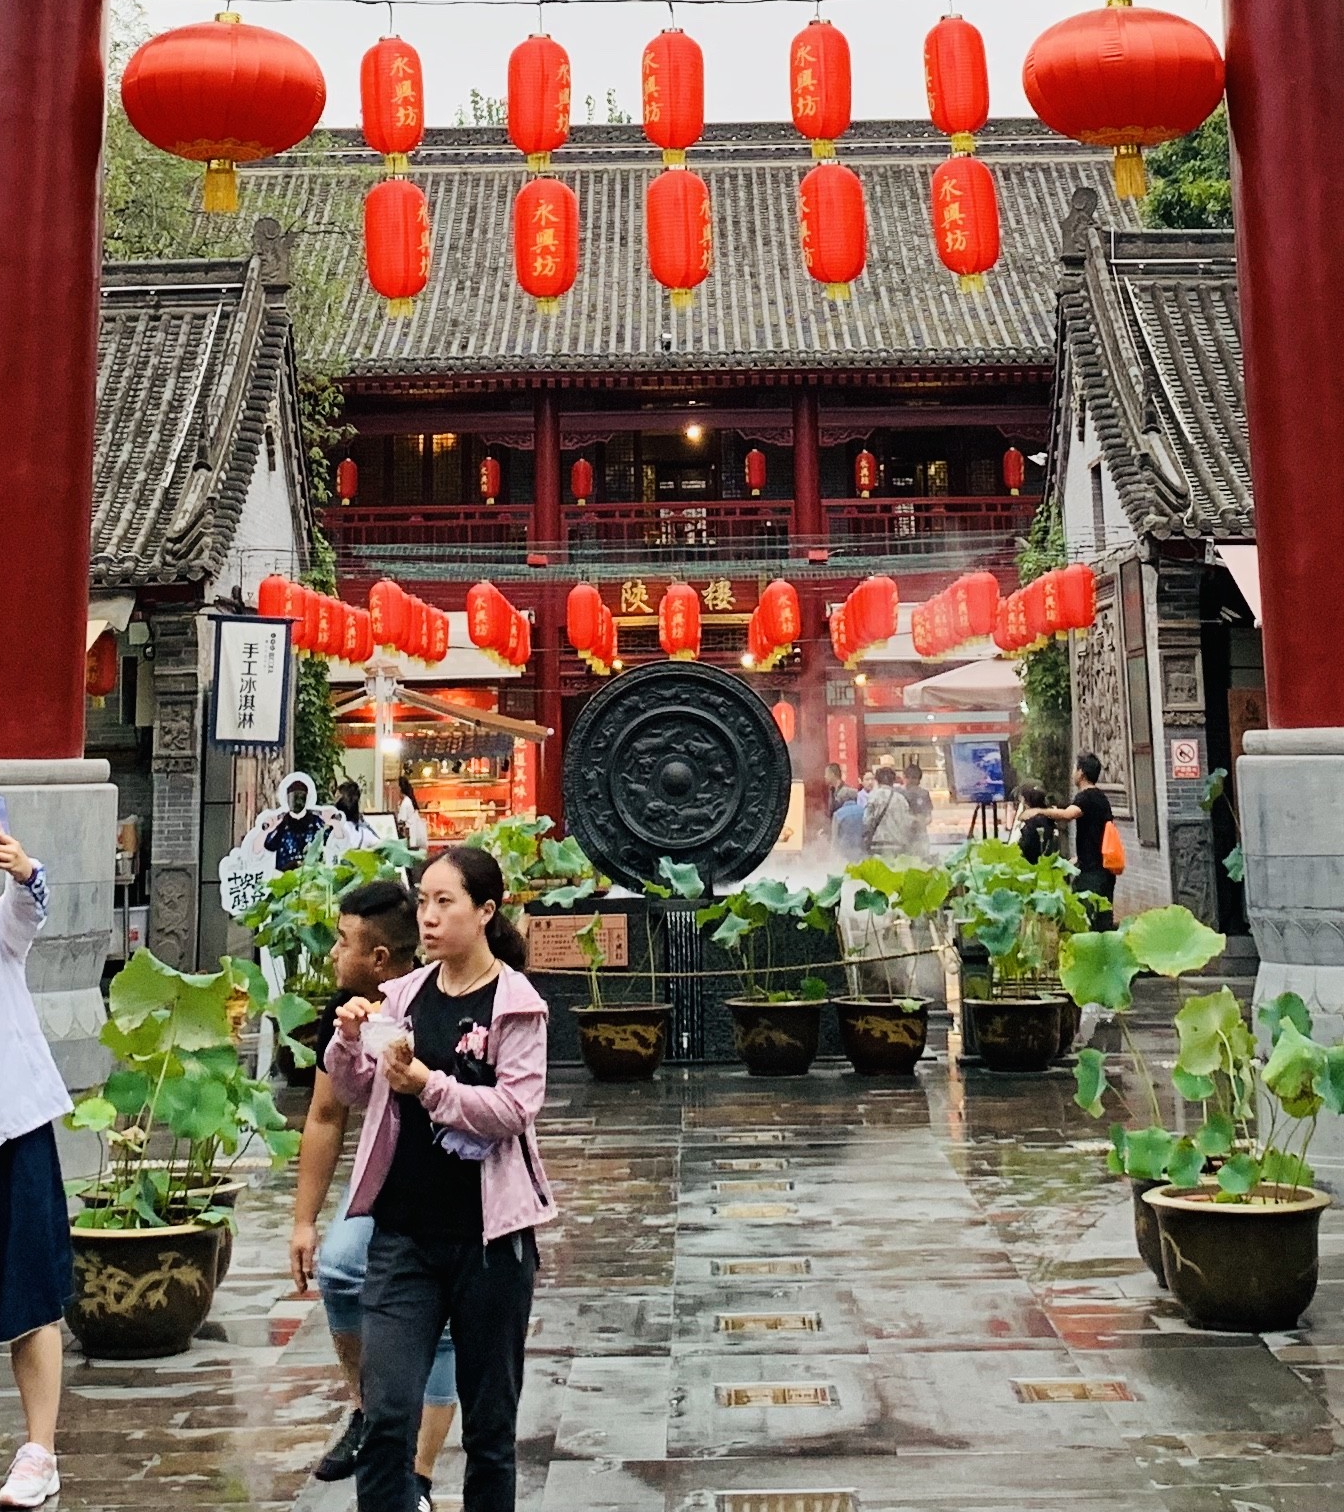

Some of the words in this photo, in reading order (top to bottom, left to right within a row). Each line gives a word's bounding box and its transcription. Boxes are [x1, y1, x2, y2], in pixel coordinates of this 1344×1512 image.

[390, 53, 419, 128] 永興坊
[794, 42, 820, 118] 永興坊
[530, 199, 561, 277] 永興坊
[940, 175, 971, 254] 永興坊
[237, 642, 260, 729] 手工冰淇淋
